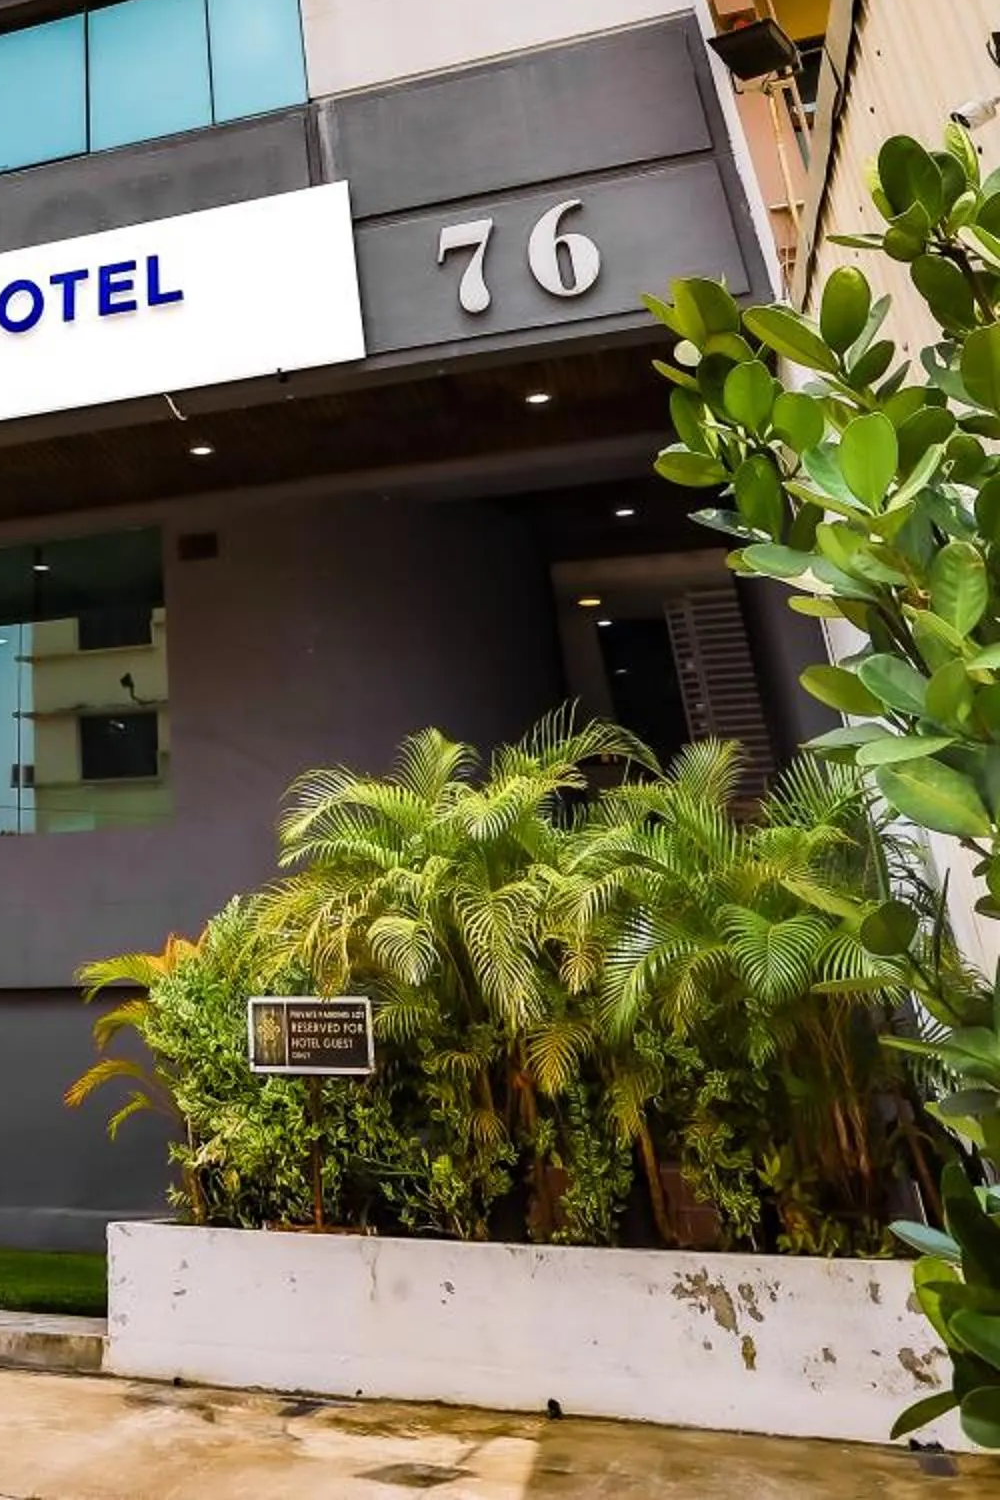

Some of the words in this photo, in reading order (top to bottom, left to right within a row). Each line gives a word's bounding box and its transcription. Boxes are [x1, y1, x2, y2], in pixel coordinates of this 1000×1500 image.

[437, 197, 601, 314] 76
[291, 1021, 341, 1033] RESERVED
[343, 1022, 365, 1034] FOR
[291, 1037, 321, 1049] HOTEL
[323, 1037, 353, 1049] GUEST
